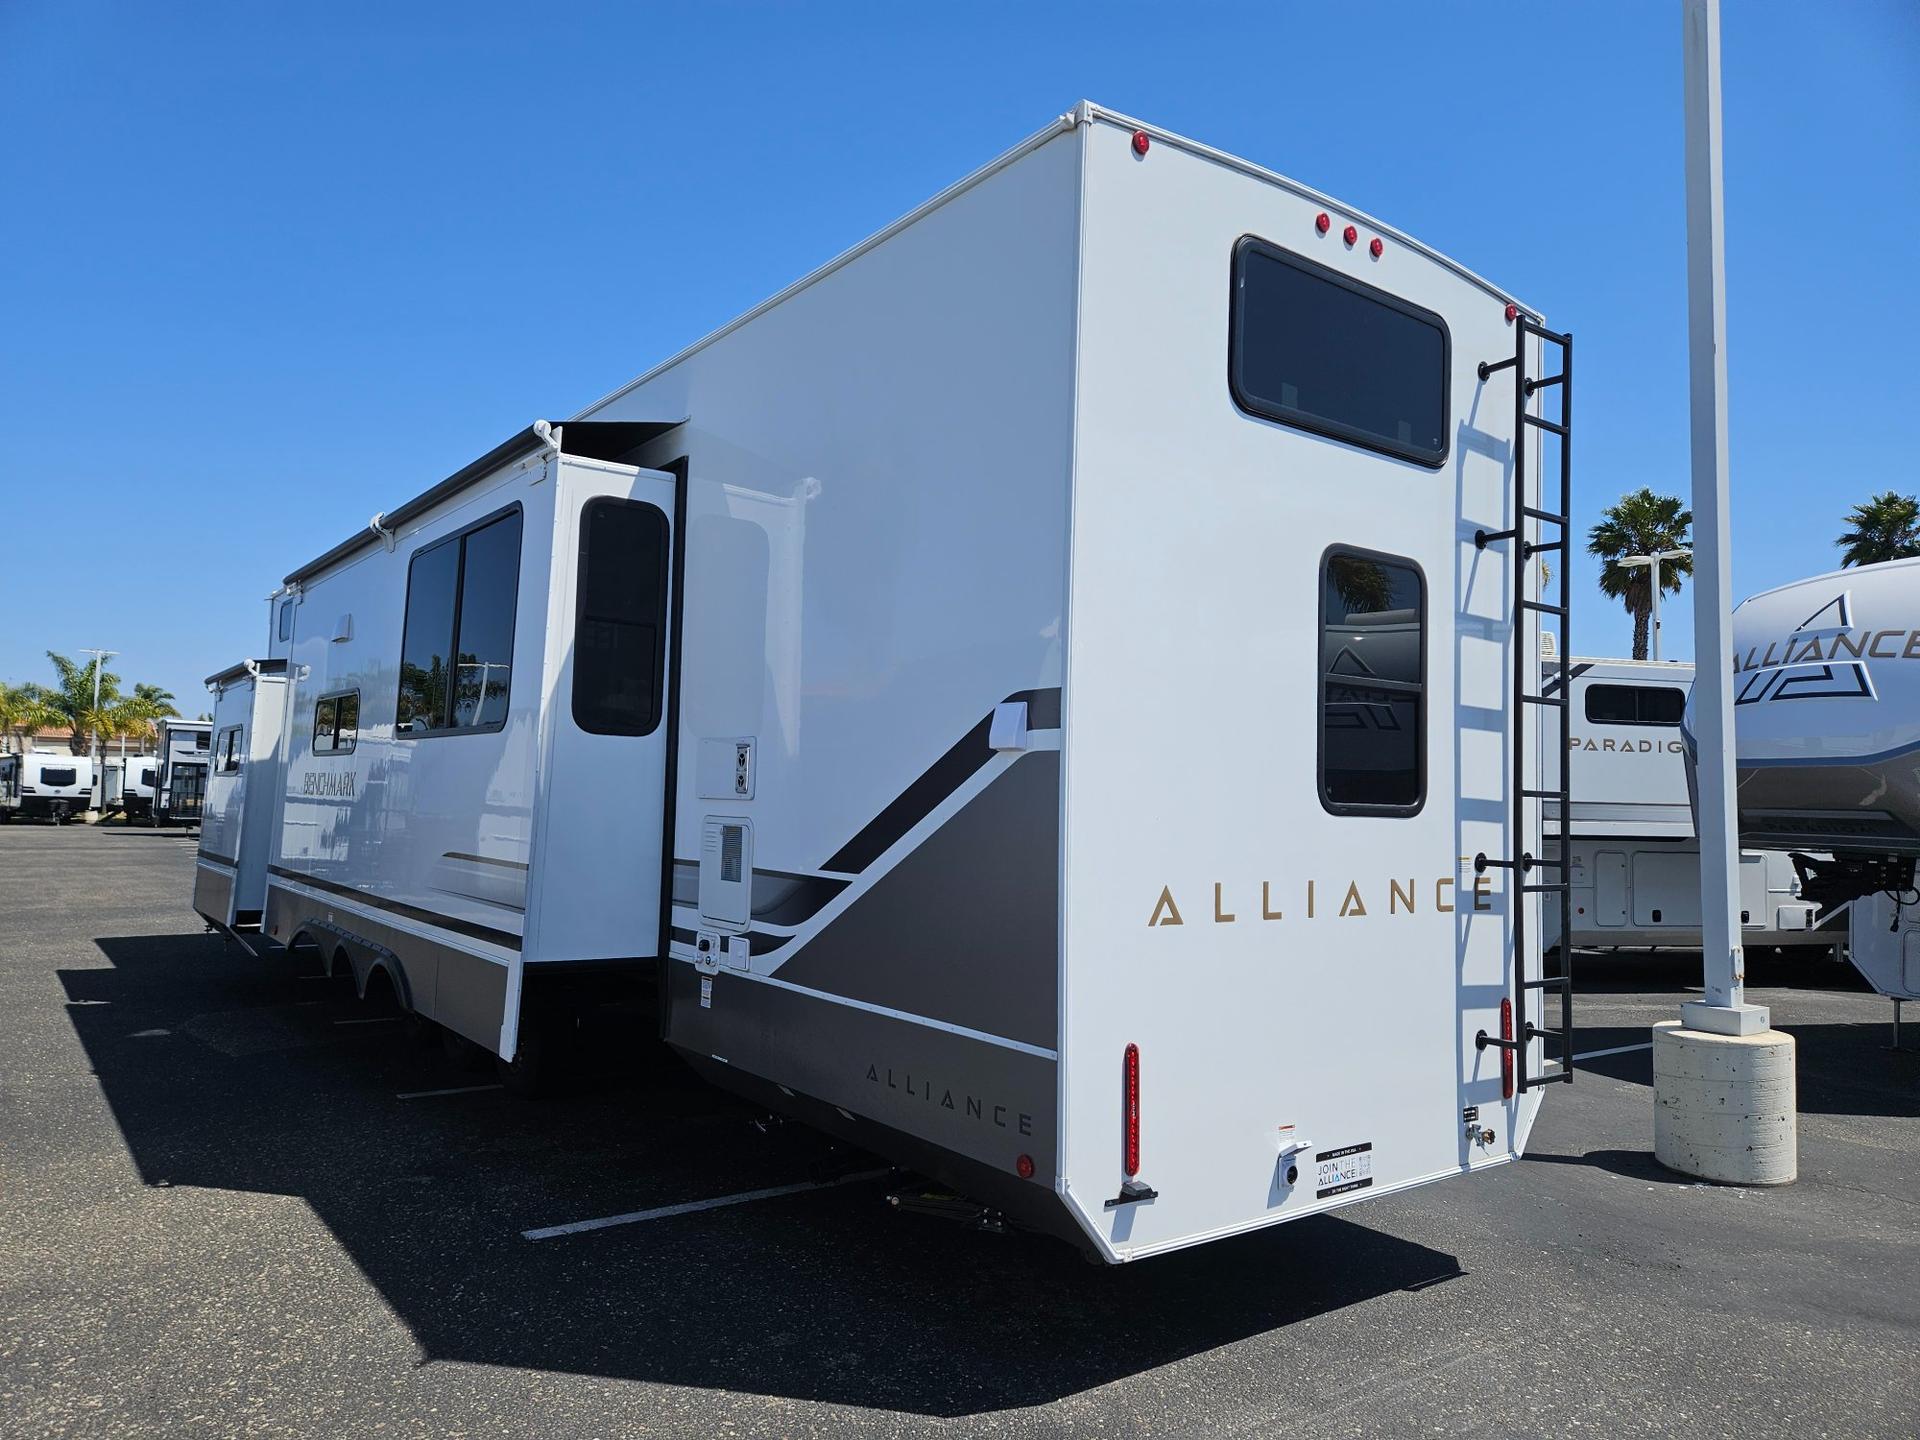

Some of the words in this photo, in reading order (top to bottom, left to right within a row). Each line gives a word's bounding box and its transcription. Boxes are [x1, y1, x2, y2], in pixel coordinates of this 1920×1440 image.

[303, 771, 357, 797] BENCHMARK
[1147, 876, 1492, 927] ALLIANCE
[866, 1063, 1032, 1137] ALLIANCE
[1318, 1161, 1338, 1176] JOIN
[1318, 1168, 1356, 1186] ALLIANCE
